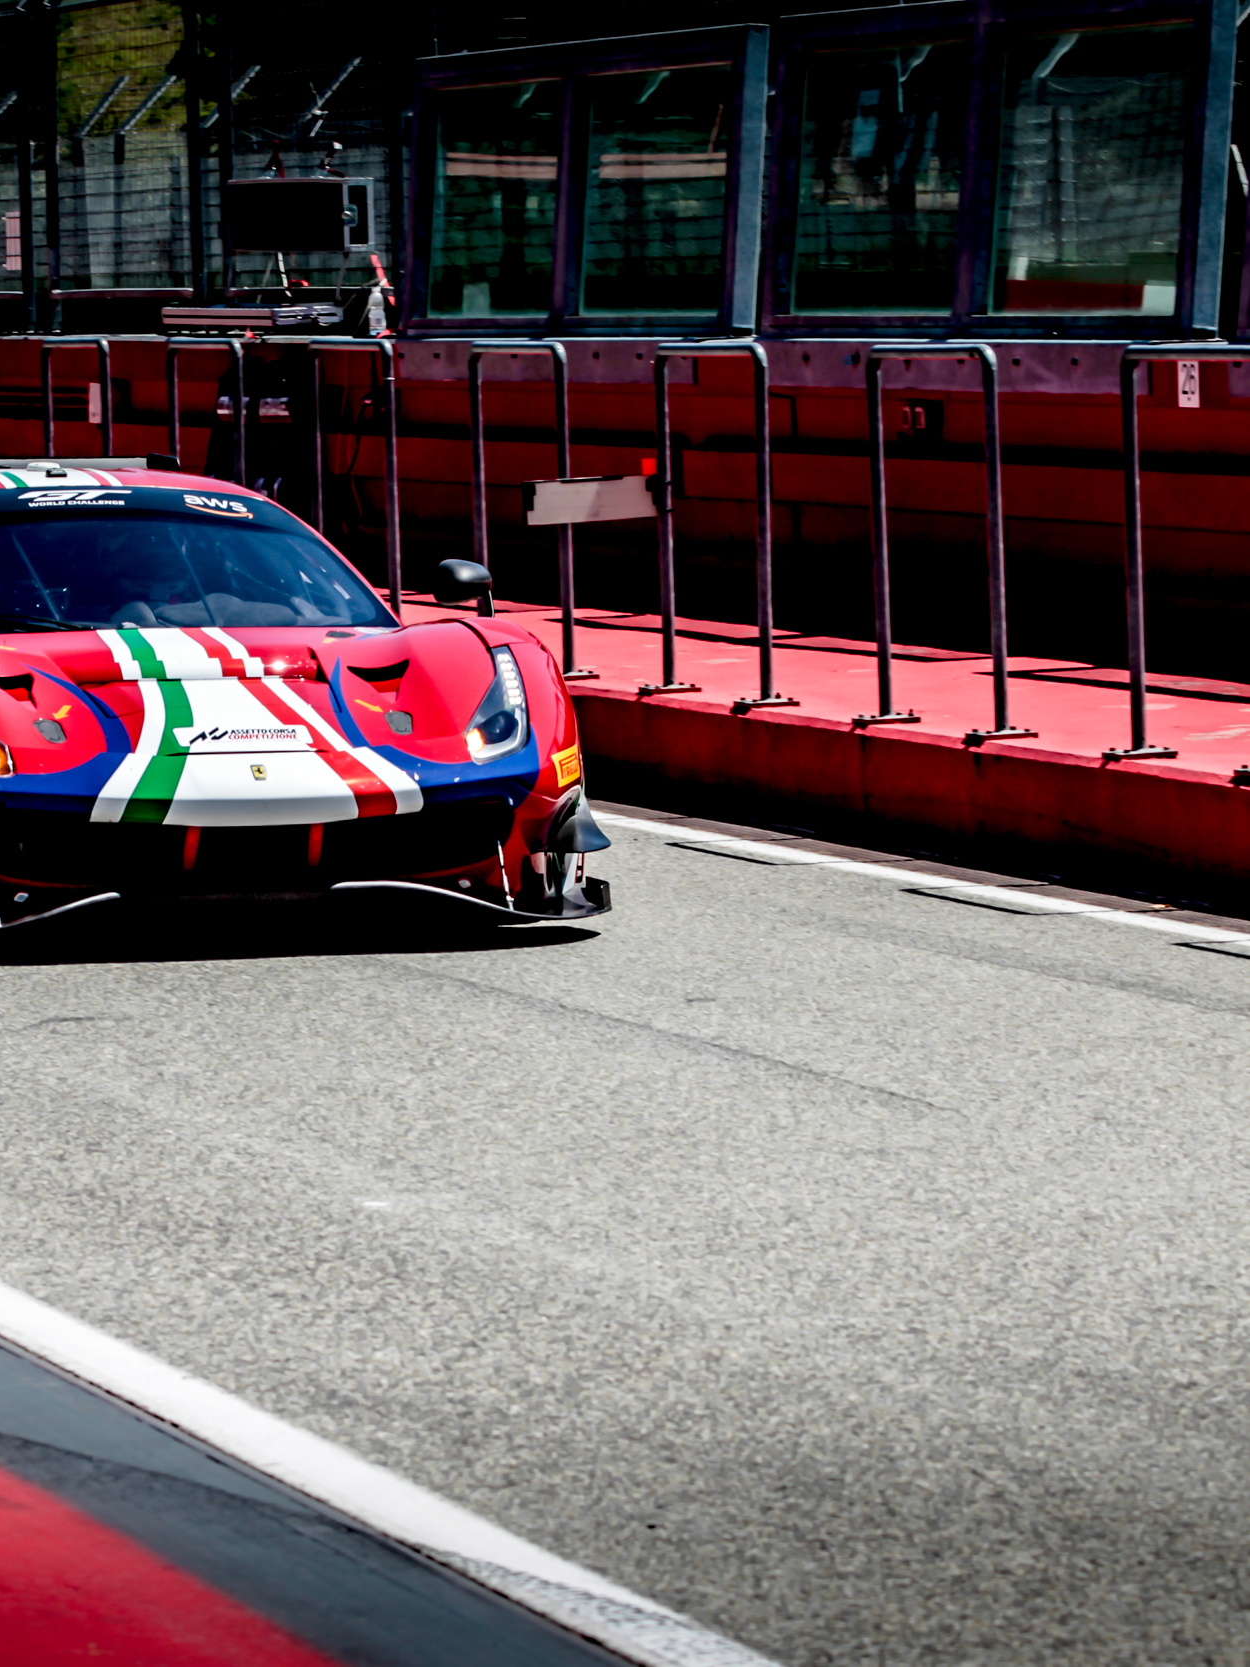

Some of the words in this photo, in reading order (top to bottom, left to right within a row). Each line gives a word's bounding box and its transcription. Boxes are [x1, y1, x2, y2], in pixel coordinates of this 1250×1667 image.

[1181, 363, 1197, 395] 26
[17, 489, 133, 502] GT
[183, 494, 248, 513] aws
[228, 733, 298, 741] COMPETIZIONE
